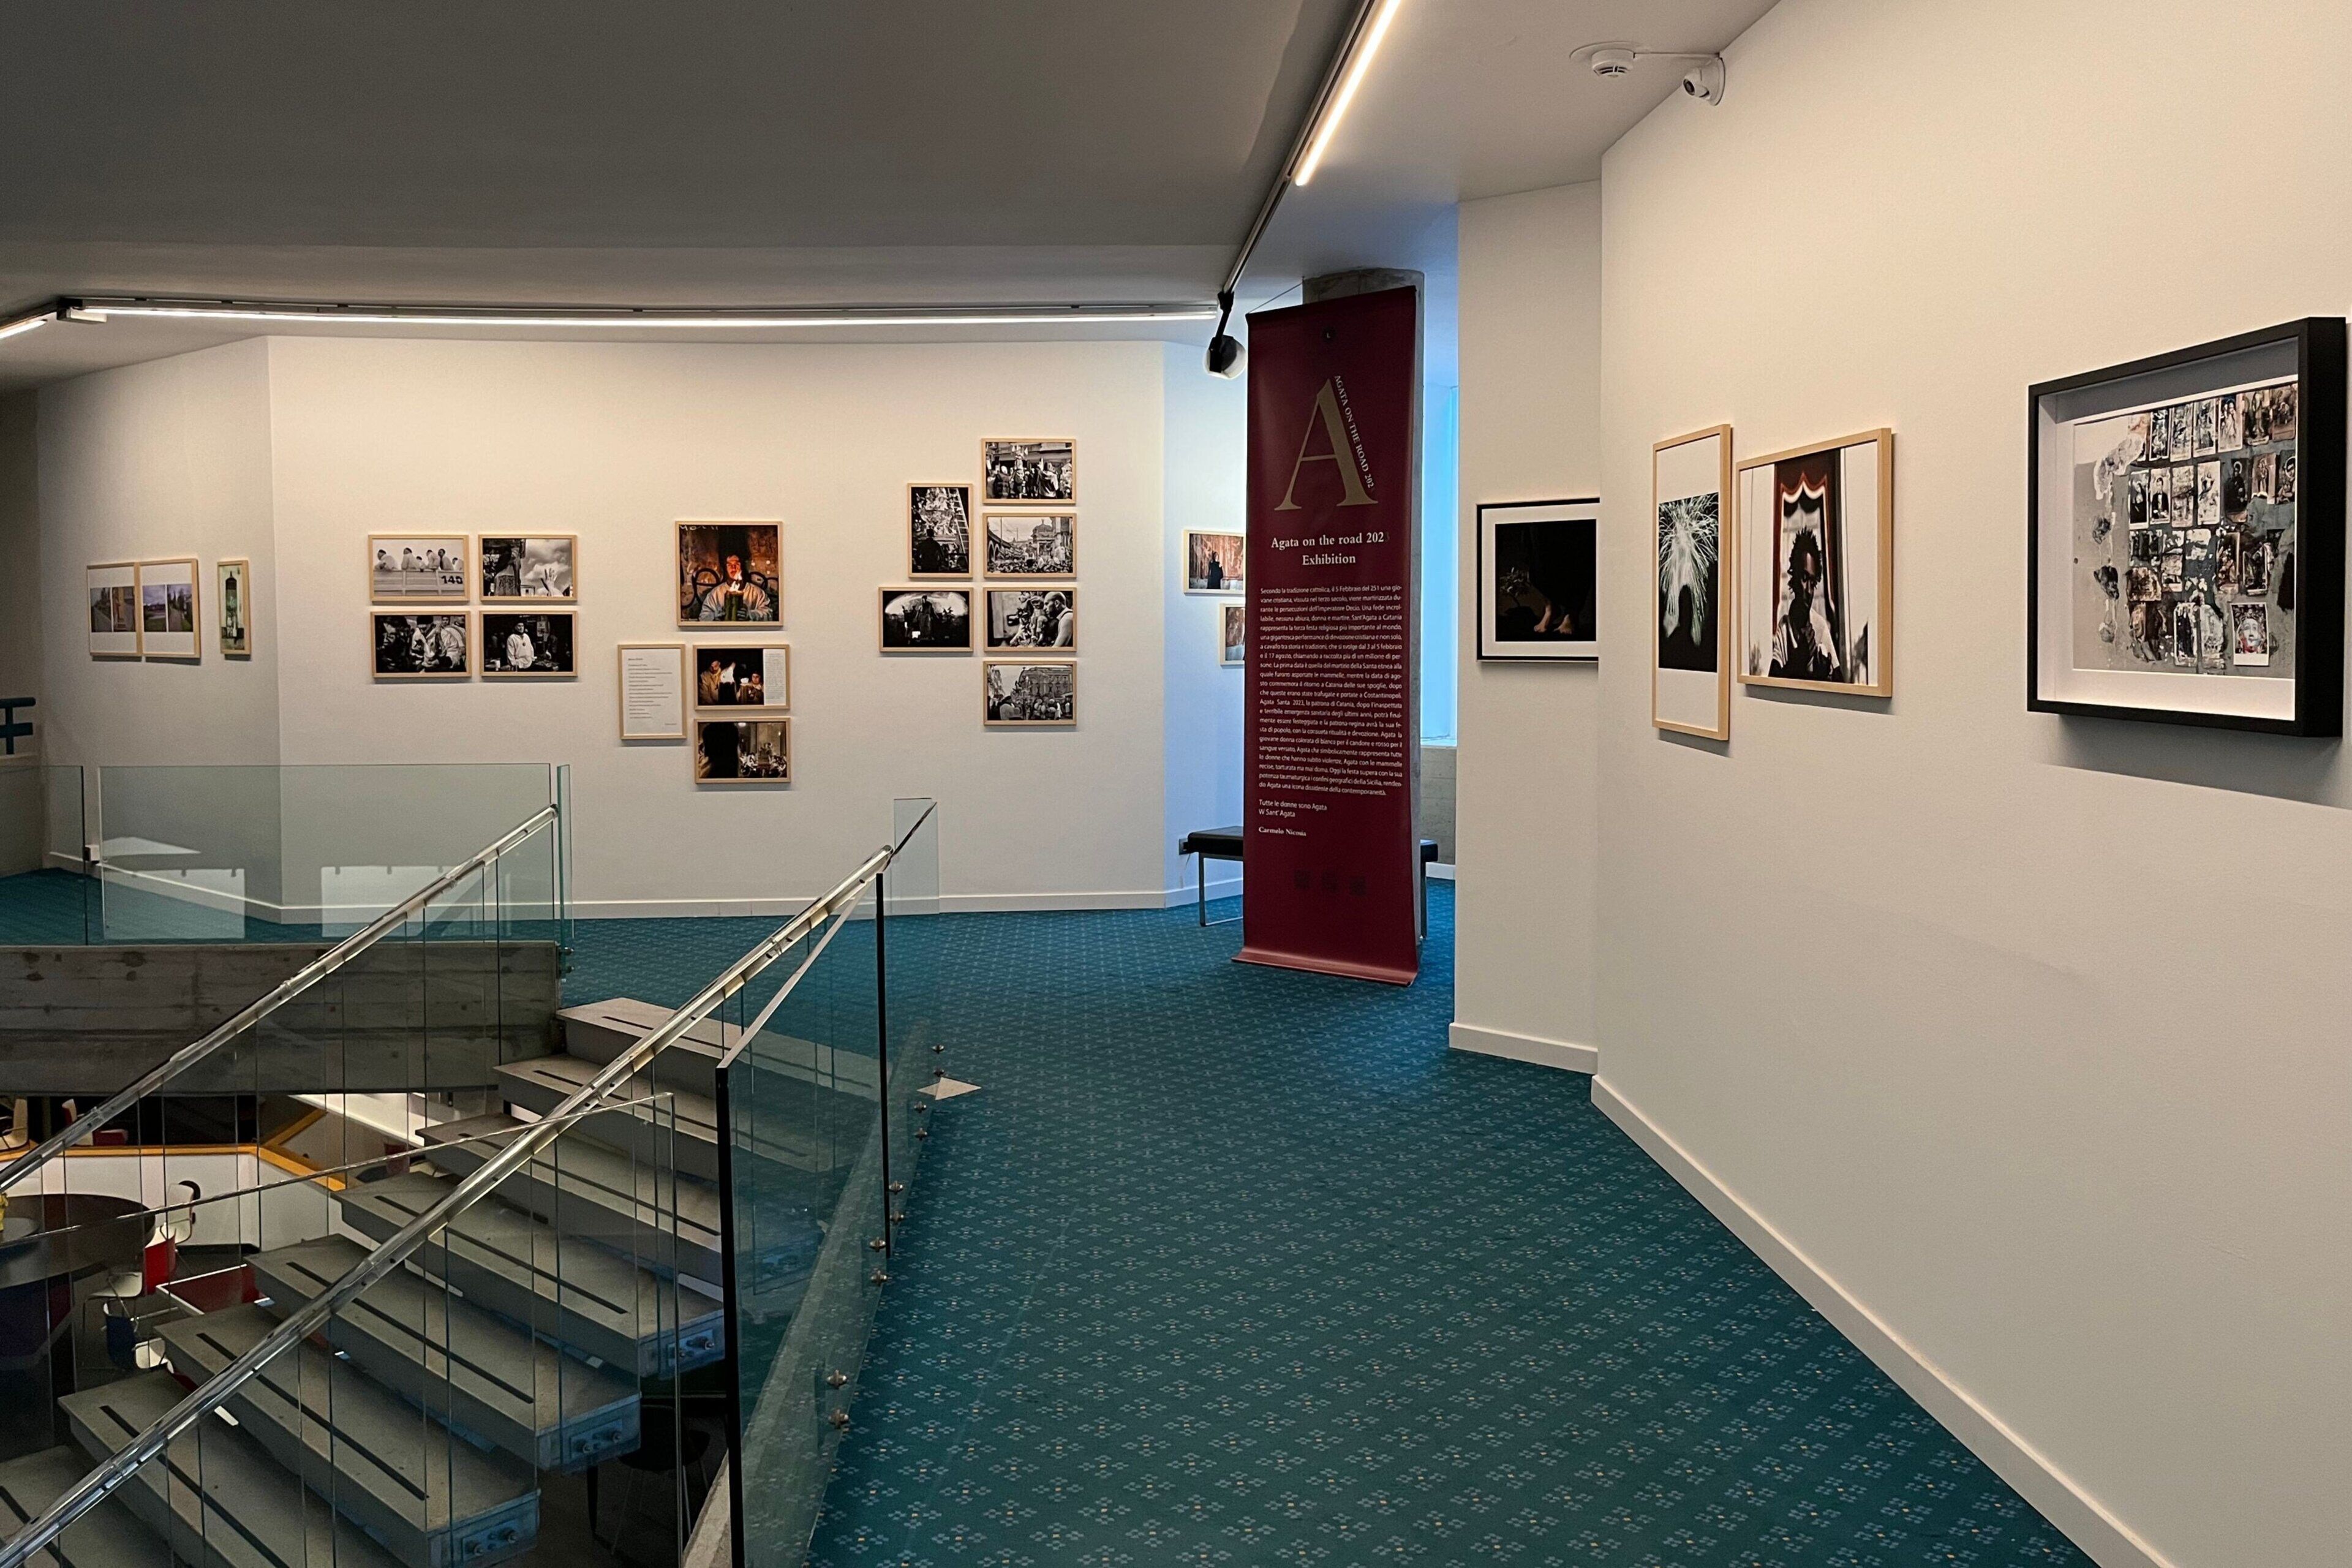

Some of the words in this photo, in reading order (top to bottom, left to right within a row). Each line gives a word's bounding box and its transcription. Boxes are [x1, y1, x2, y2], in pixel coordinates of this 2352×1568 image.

[1335, 375, 1348, 406] AGATA
[1345, 407, 1354, 423] ON
[1349, 422, 1360, 444] THE
[1355, 443, 1369, 472] ROAD
[1271, 537, 1299, 551] Agata
[1319, 534, 1335, 546] the
[1338, 532, 1363, 545] road
[1302, 553, 1356, 565] Exhibition
[1280, 810, 1295, 818] Agata
[1311, 803, 1327, 812] Agata
